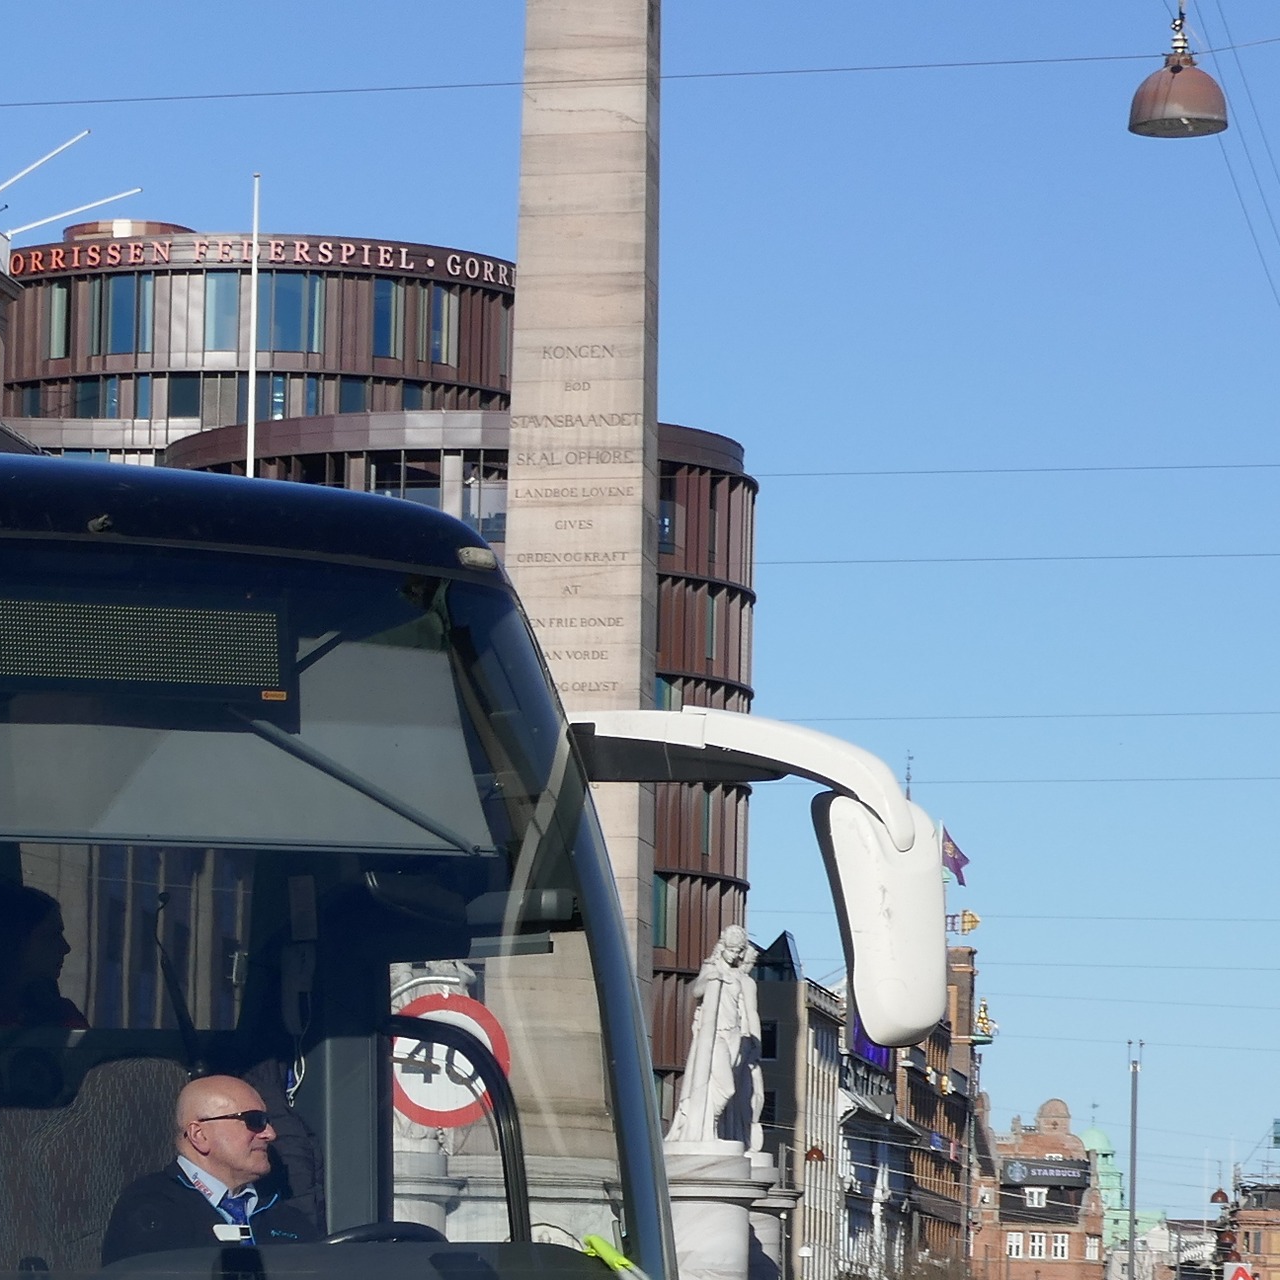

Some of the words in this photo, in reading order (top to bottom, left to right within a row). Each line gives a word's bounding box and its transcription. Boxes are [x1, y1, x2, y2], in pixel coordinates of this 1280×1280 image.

[10, 240, 173, 276] ORRISSEN
[193, 240, 416, 270] FEDERSPIEL
[446, 253, 517, 288] GORRI
[542, 344, 615, 359] KONGEN
[510, 412, 642, 429] STAVNSBAANDET
[516, 452, 562, 466] SKAL
[565, 450, 635, 465] OPHØRE
[515, 488, 578, 499] LANDBOE
[581, 486, 635, 498] LOVENE
[554, 519, 594, 530] GIVES
[517, 552, 562, 563] ORDEN
[563, 552, 583, 562] OG
[584, 551, 630, 562] KRAFT
[561, 585, 582, 595] AT
[528, 618, 547, 628] EN
[549, 618, 578, 628] FRIE
[580, 617, 625, 628] BONDE
[544, 650, 562, 660] AN
[565, 650, 609, 660] VORDE
[571, 681, 619, 692] OPLYST
[1031, 1168, 1081, 1178] STARBUCKS
